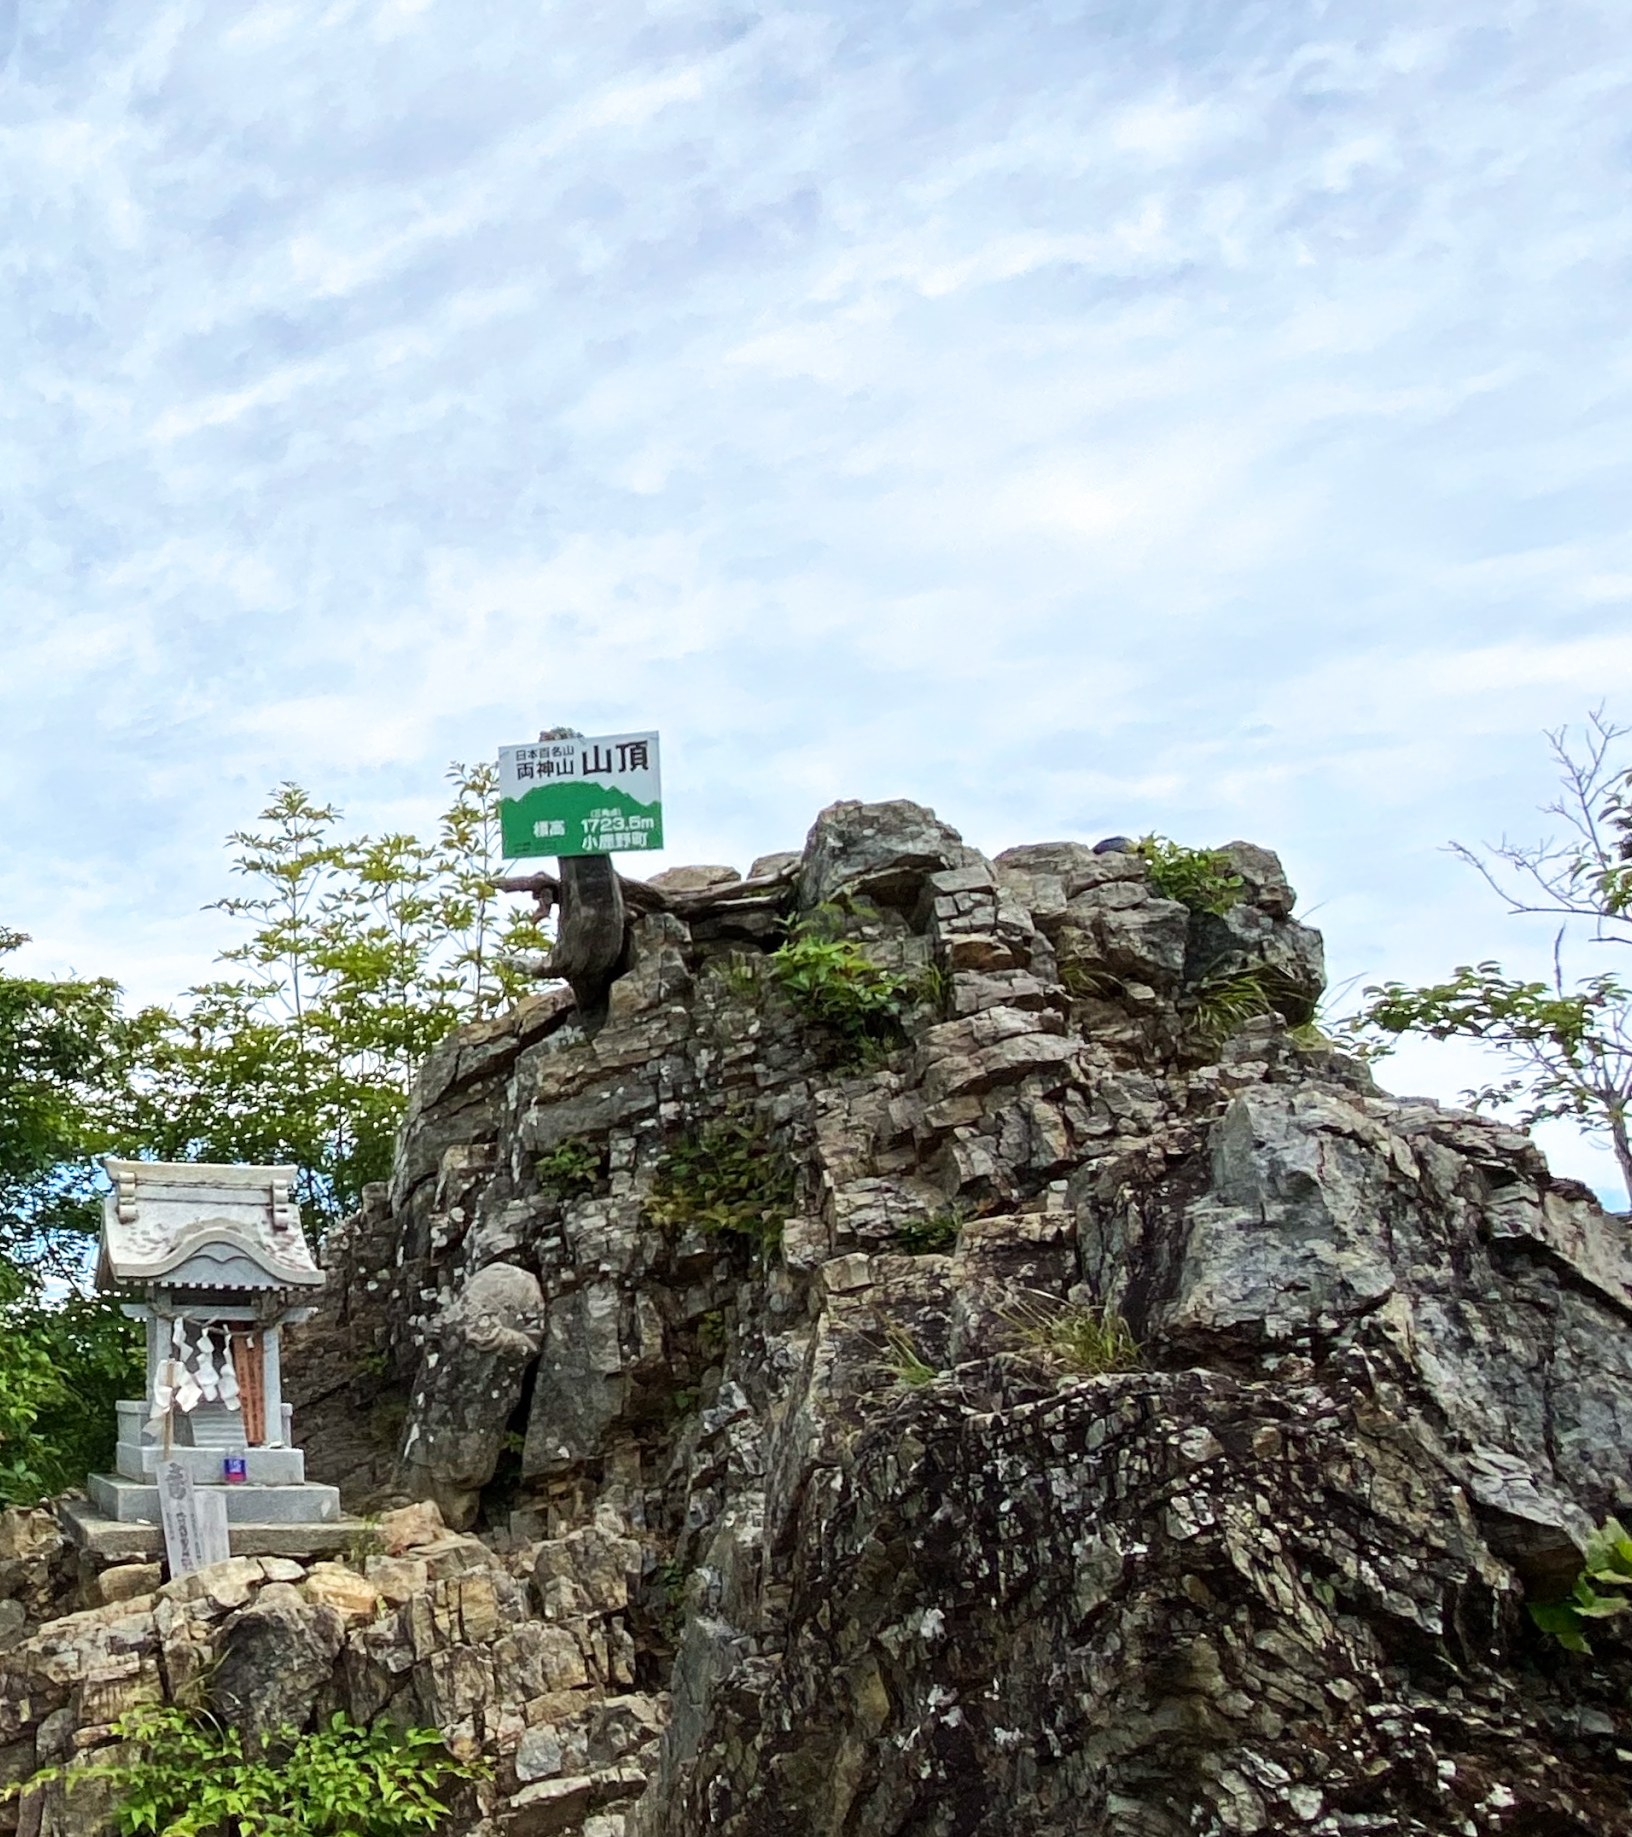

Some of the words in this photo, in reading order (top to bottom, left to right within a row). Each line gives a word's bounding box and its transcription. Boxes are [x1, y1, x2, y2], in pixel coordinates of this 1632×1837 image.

[516, 744, 574, 761] 日本百名山
[517, 758, 574, 780] 両神山
[582, 740, 649, 776] 山頂
